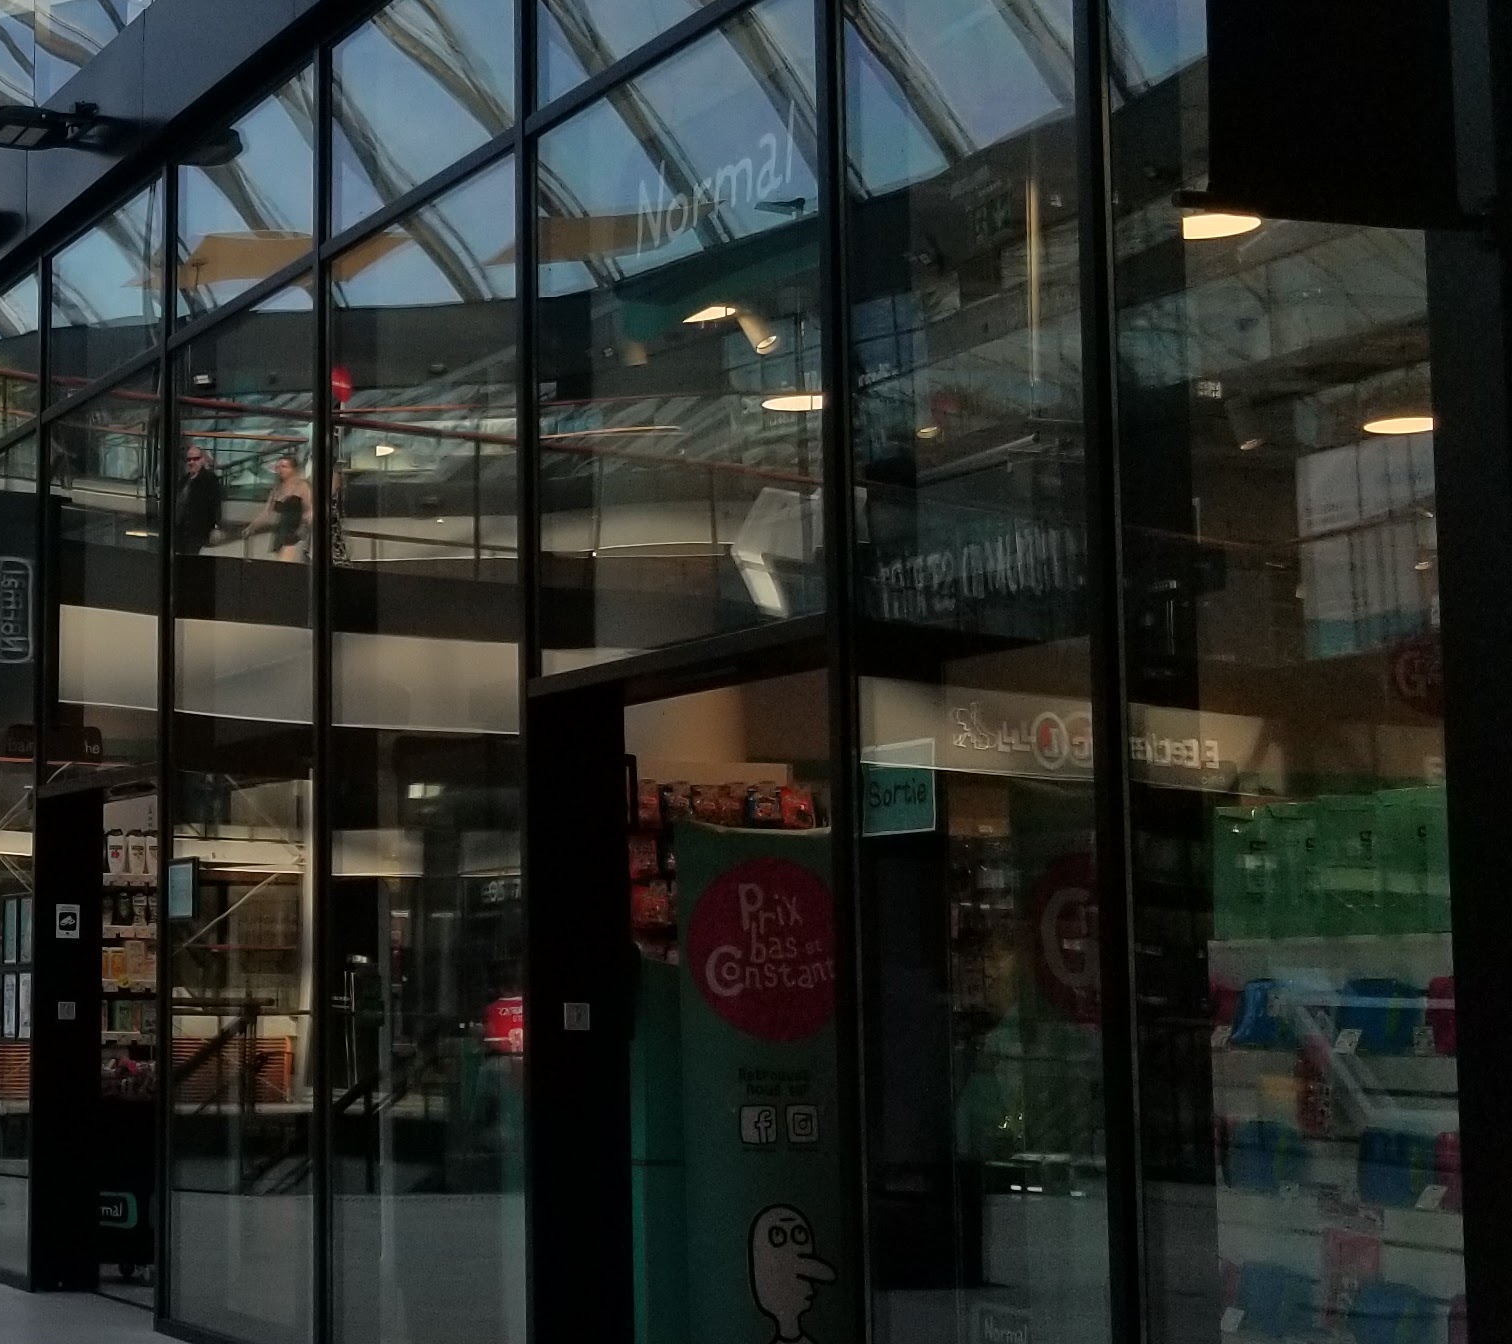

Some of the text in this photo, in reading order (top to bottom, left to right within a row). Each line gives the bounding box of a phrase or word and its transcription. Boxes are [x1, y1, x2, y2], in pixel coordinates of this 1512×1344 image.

[635, 99, 796, 259] Normal
[868, 777, 927, 808] Sortie
[737, 883, 803, 935] Prix
[750, 920, 798, 964] bas
[98, 1201, 123, 1217] mal
